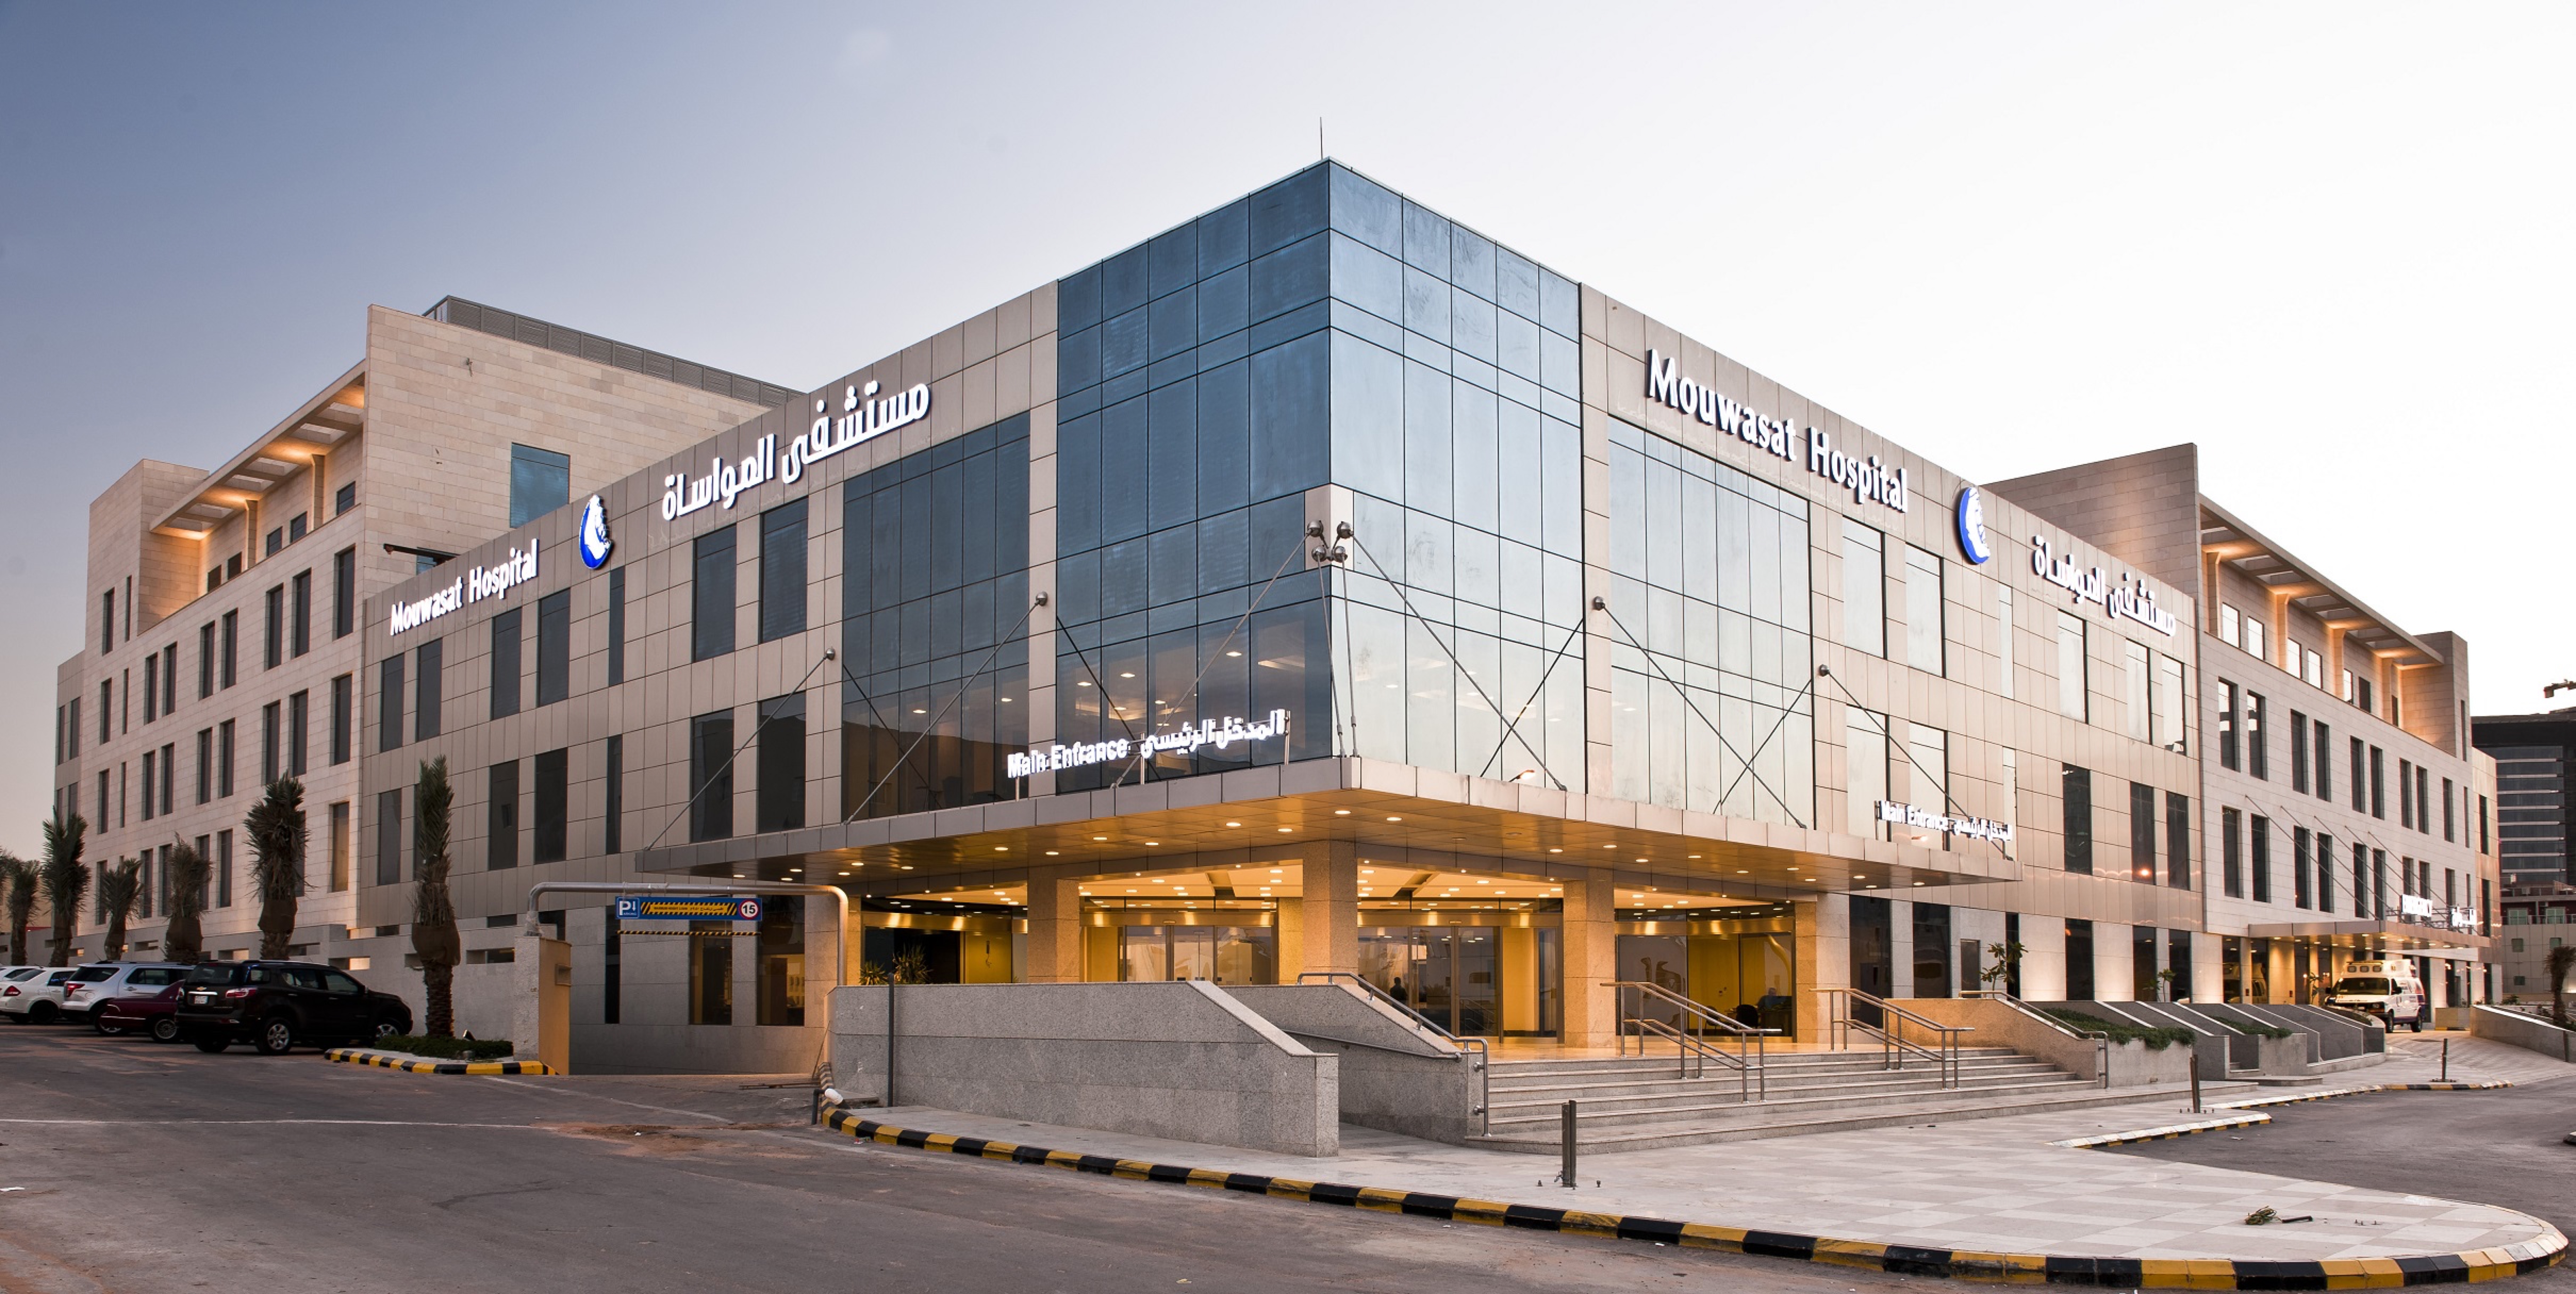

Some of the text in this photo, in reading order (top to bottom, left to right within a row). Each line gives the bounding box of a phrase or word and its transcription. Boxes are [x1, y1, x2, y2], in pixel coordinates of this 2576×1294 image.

[662, 380, 930, 521] مستشفى المواساة
[1647, 349, 1908, 513] Mouwasat Hospital
[390, 538, 539, 636] Mouwasat Hospital
[2033, 535, 2176, 637] مستشفى المواساة
[1007, 739, 1128, 778] Main Entrance
[1881, 800, 1948, 831] Main Entrance
[620, 901, 631, 916] P
[743, 905, 755, 914] 15
